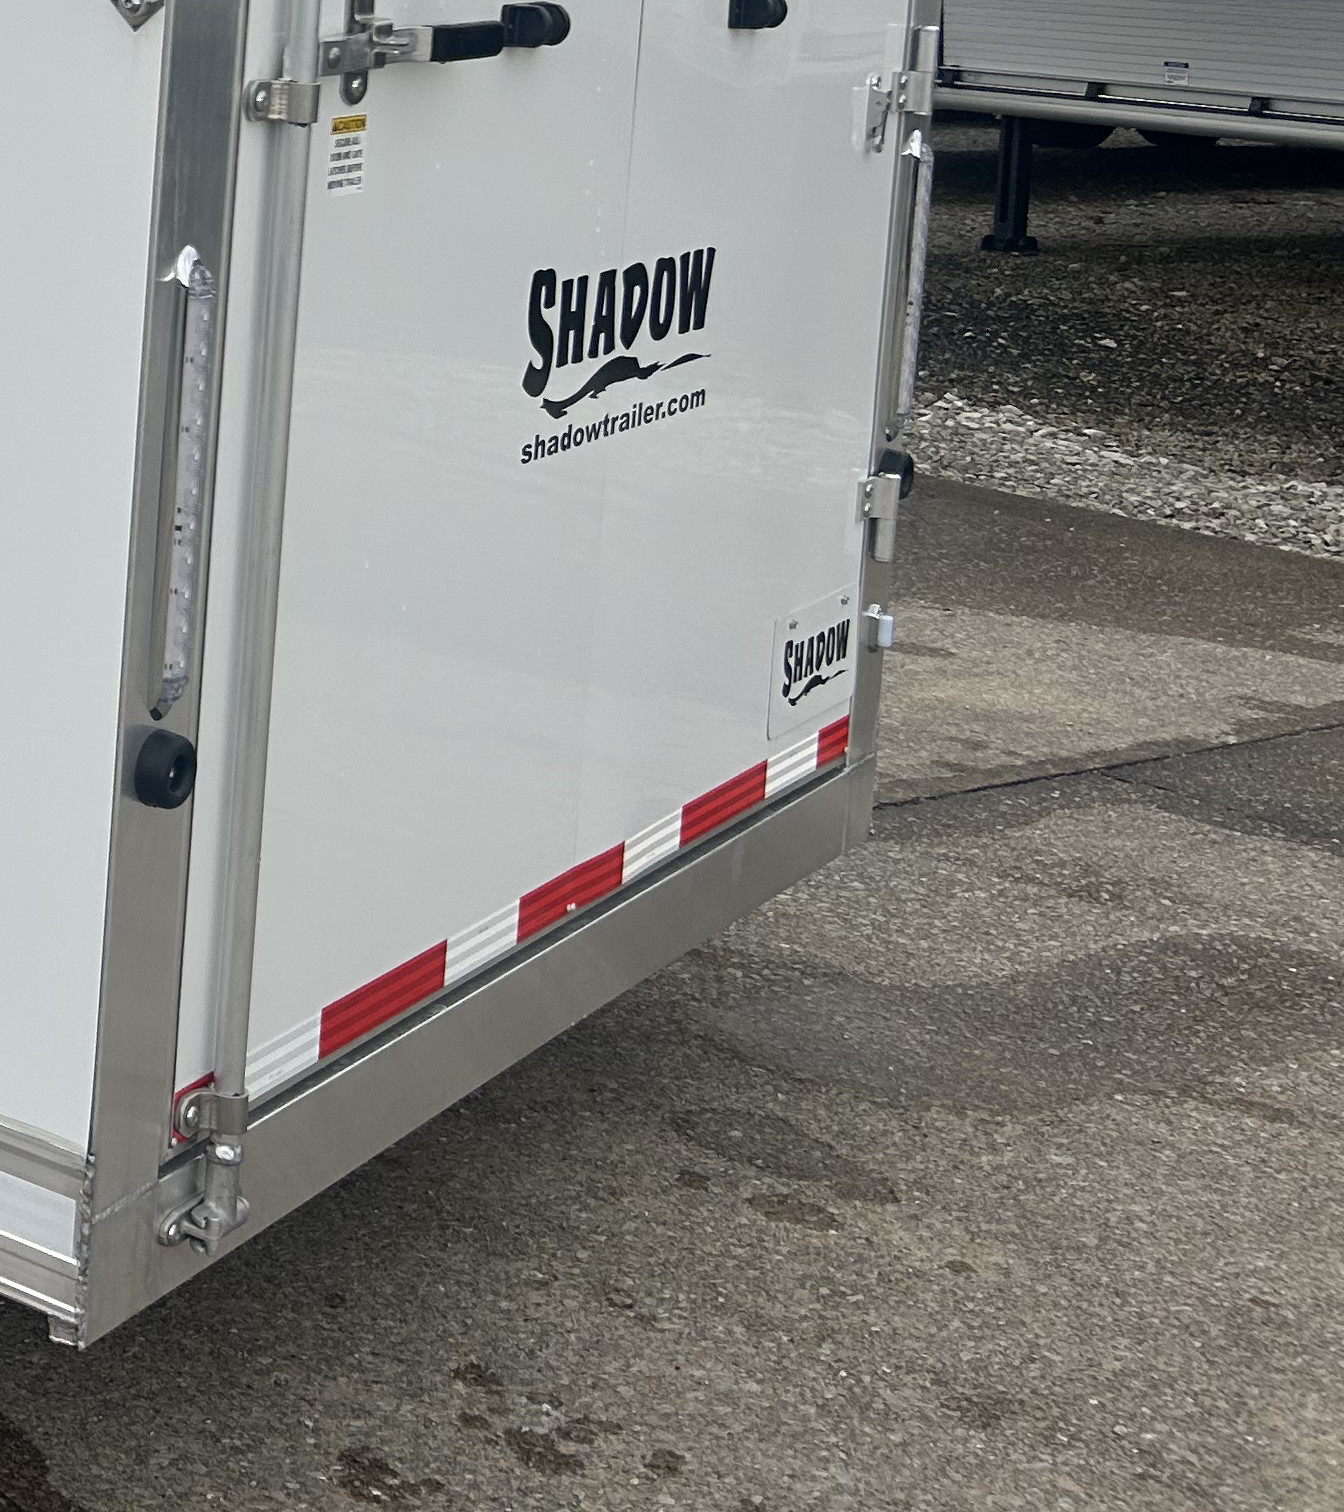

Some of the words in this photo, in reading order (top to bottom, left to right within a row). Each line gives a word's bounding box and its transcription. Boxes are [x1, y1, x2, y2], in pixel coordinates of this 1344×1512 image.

[521, 246, 716, 398] SHADOW
[520, 388, 706, 465] shadowtrailer.com
[781, 618, 851, 698] SHADOW
